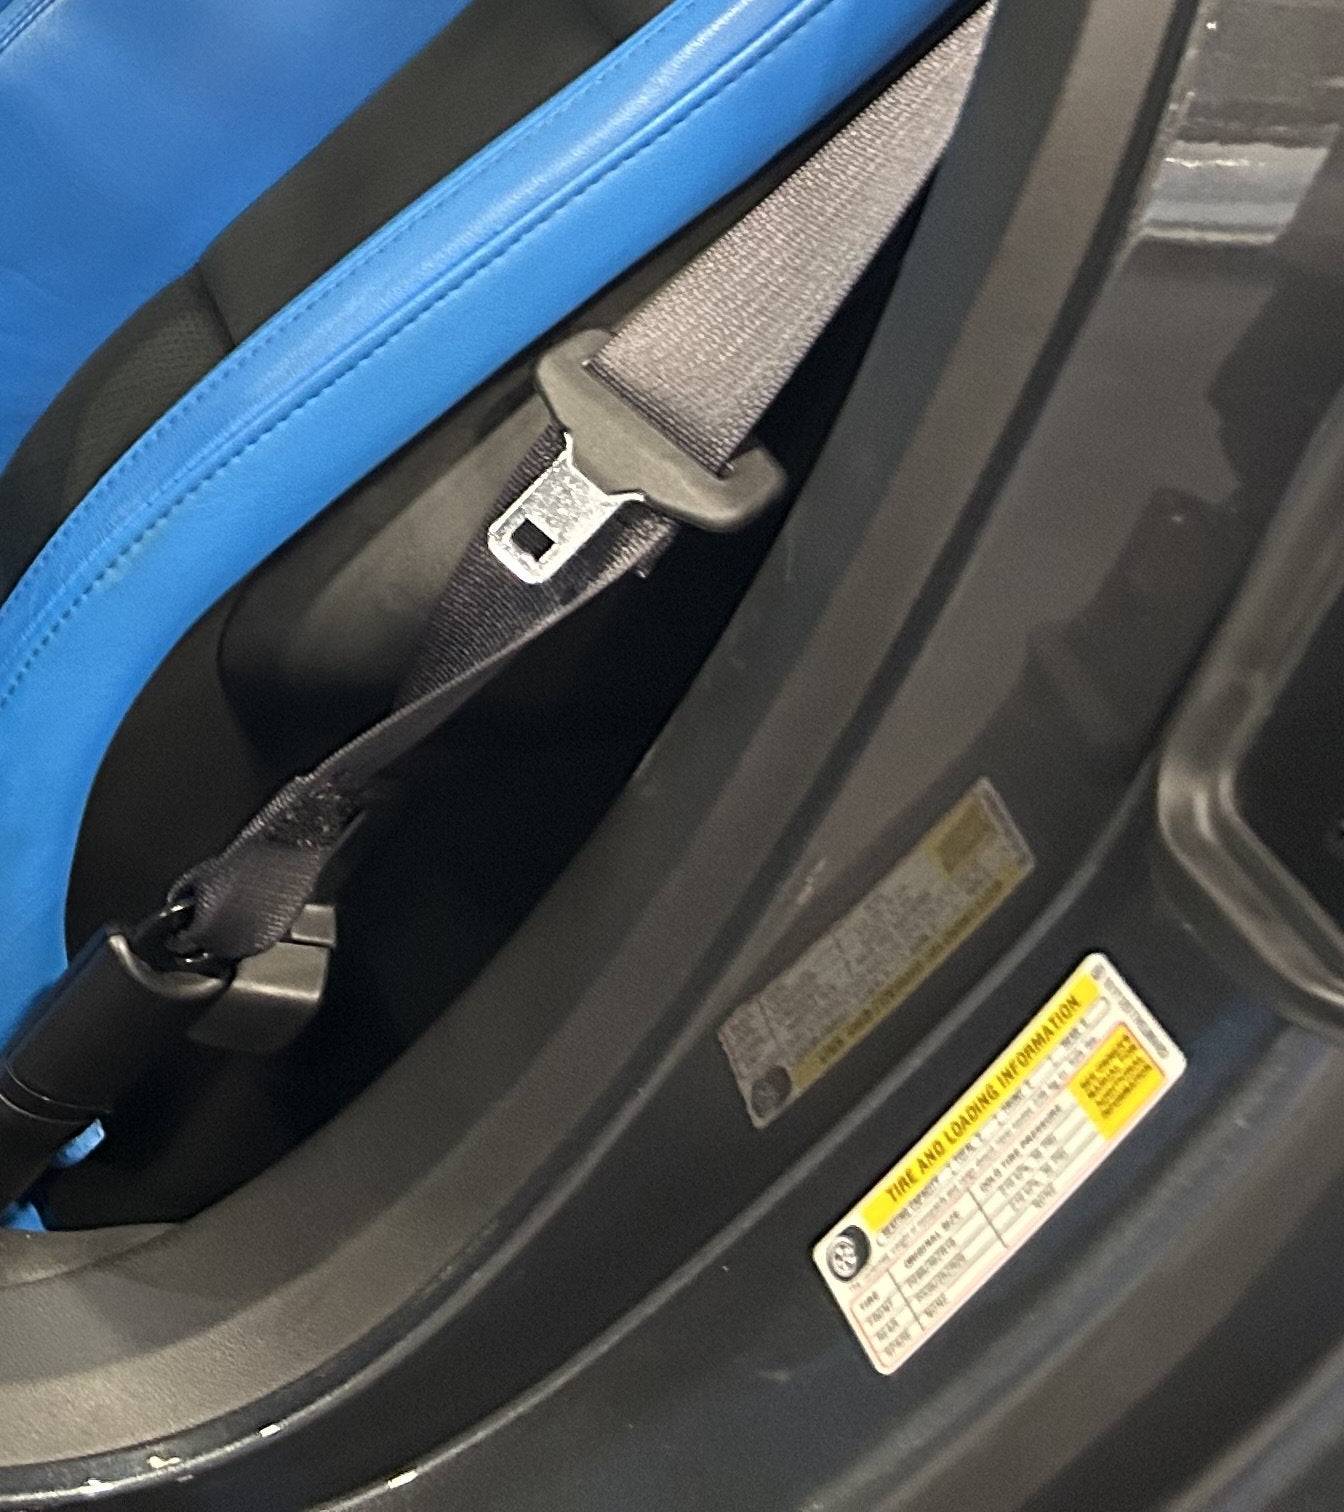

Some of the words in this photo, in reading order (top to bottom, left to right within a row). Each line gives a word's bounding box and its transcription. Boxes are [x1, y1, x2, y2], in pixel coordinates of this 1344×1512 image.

[884, 1165, 919, 1206] TIRE
[913, 1136, 946, 1174] AND
[941, 1080, 1000, 1146] LOADING
[993, 992, 1083, 1089] INFORMATION
